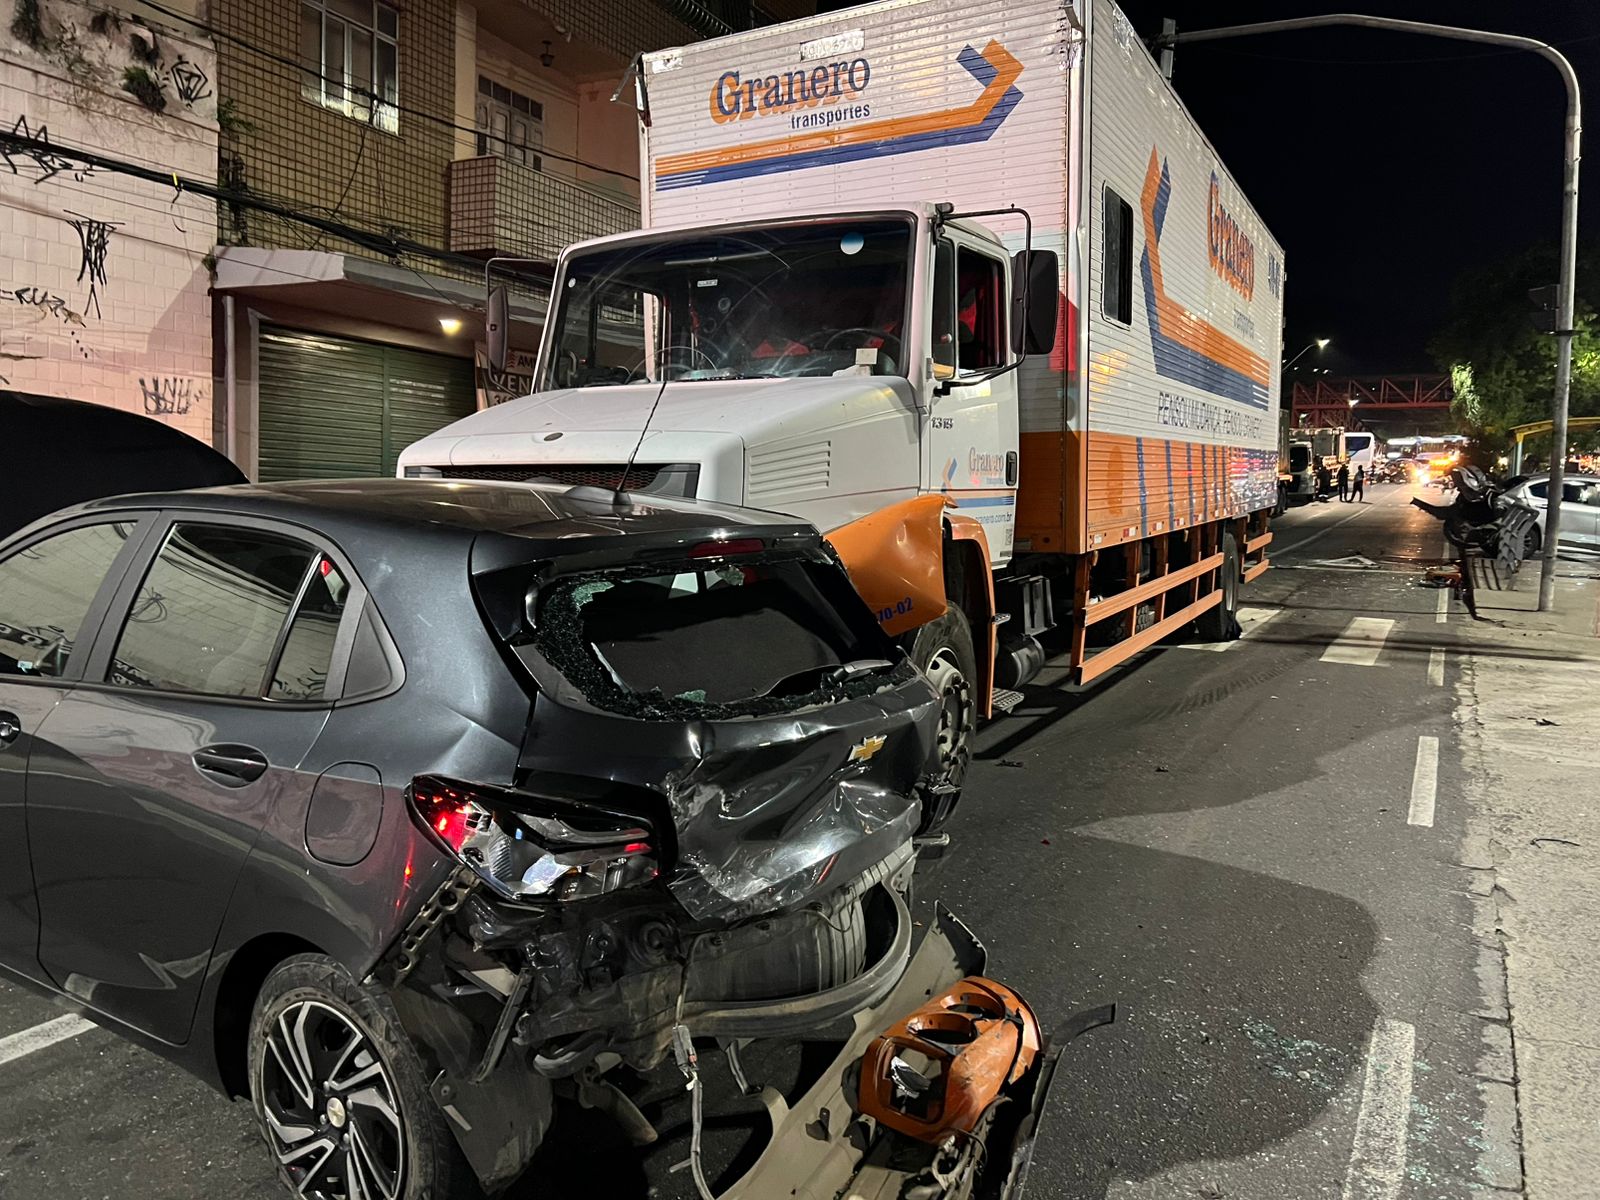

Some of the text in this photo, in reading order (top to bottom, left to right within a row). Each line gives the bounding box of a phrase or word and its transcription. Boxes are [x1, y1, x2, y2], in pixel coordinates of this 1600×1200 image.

[712, 58, 870, 121] Granero
[791, 104, 870, 129] transportes
[1208, 169, 1254, 301] Granero
[969, 446, 1004, 473] Granero
